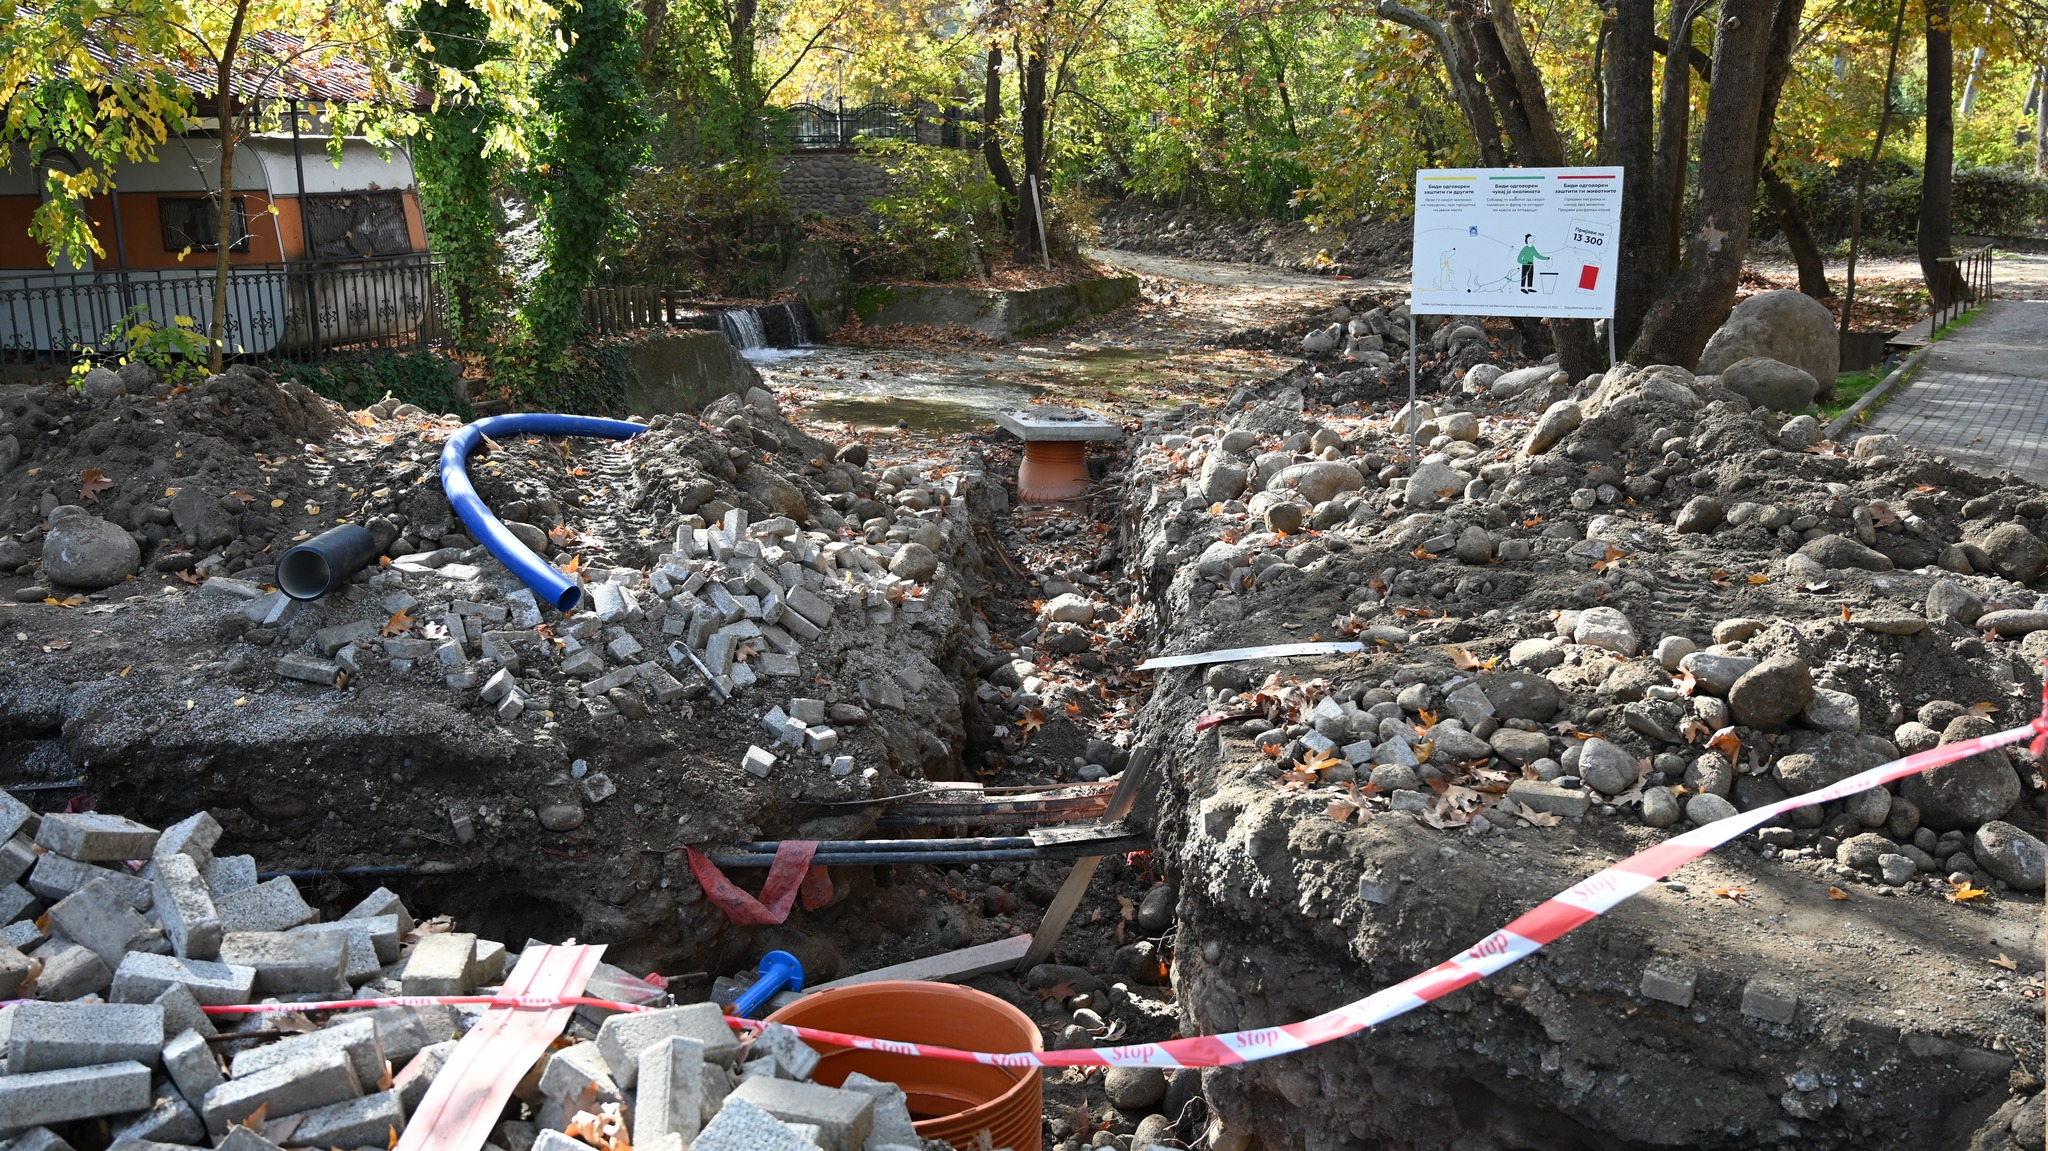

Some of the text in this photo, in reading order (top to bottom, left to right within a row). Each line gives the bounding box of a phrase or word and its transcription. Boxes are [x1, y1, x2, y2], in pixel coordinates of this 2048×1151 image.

[1573, 233, 1603, 246] 13 300
[1237, 1030, 1279, 1048] Stop
[1112, 1045, 1154, 1063] Stop
